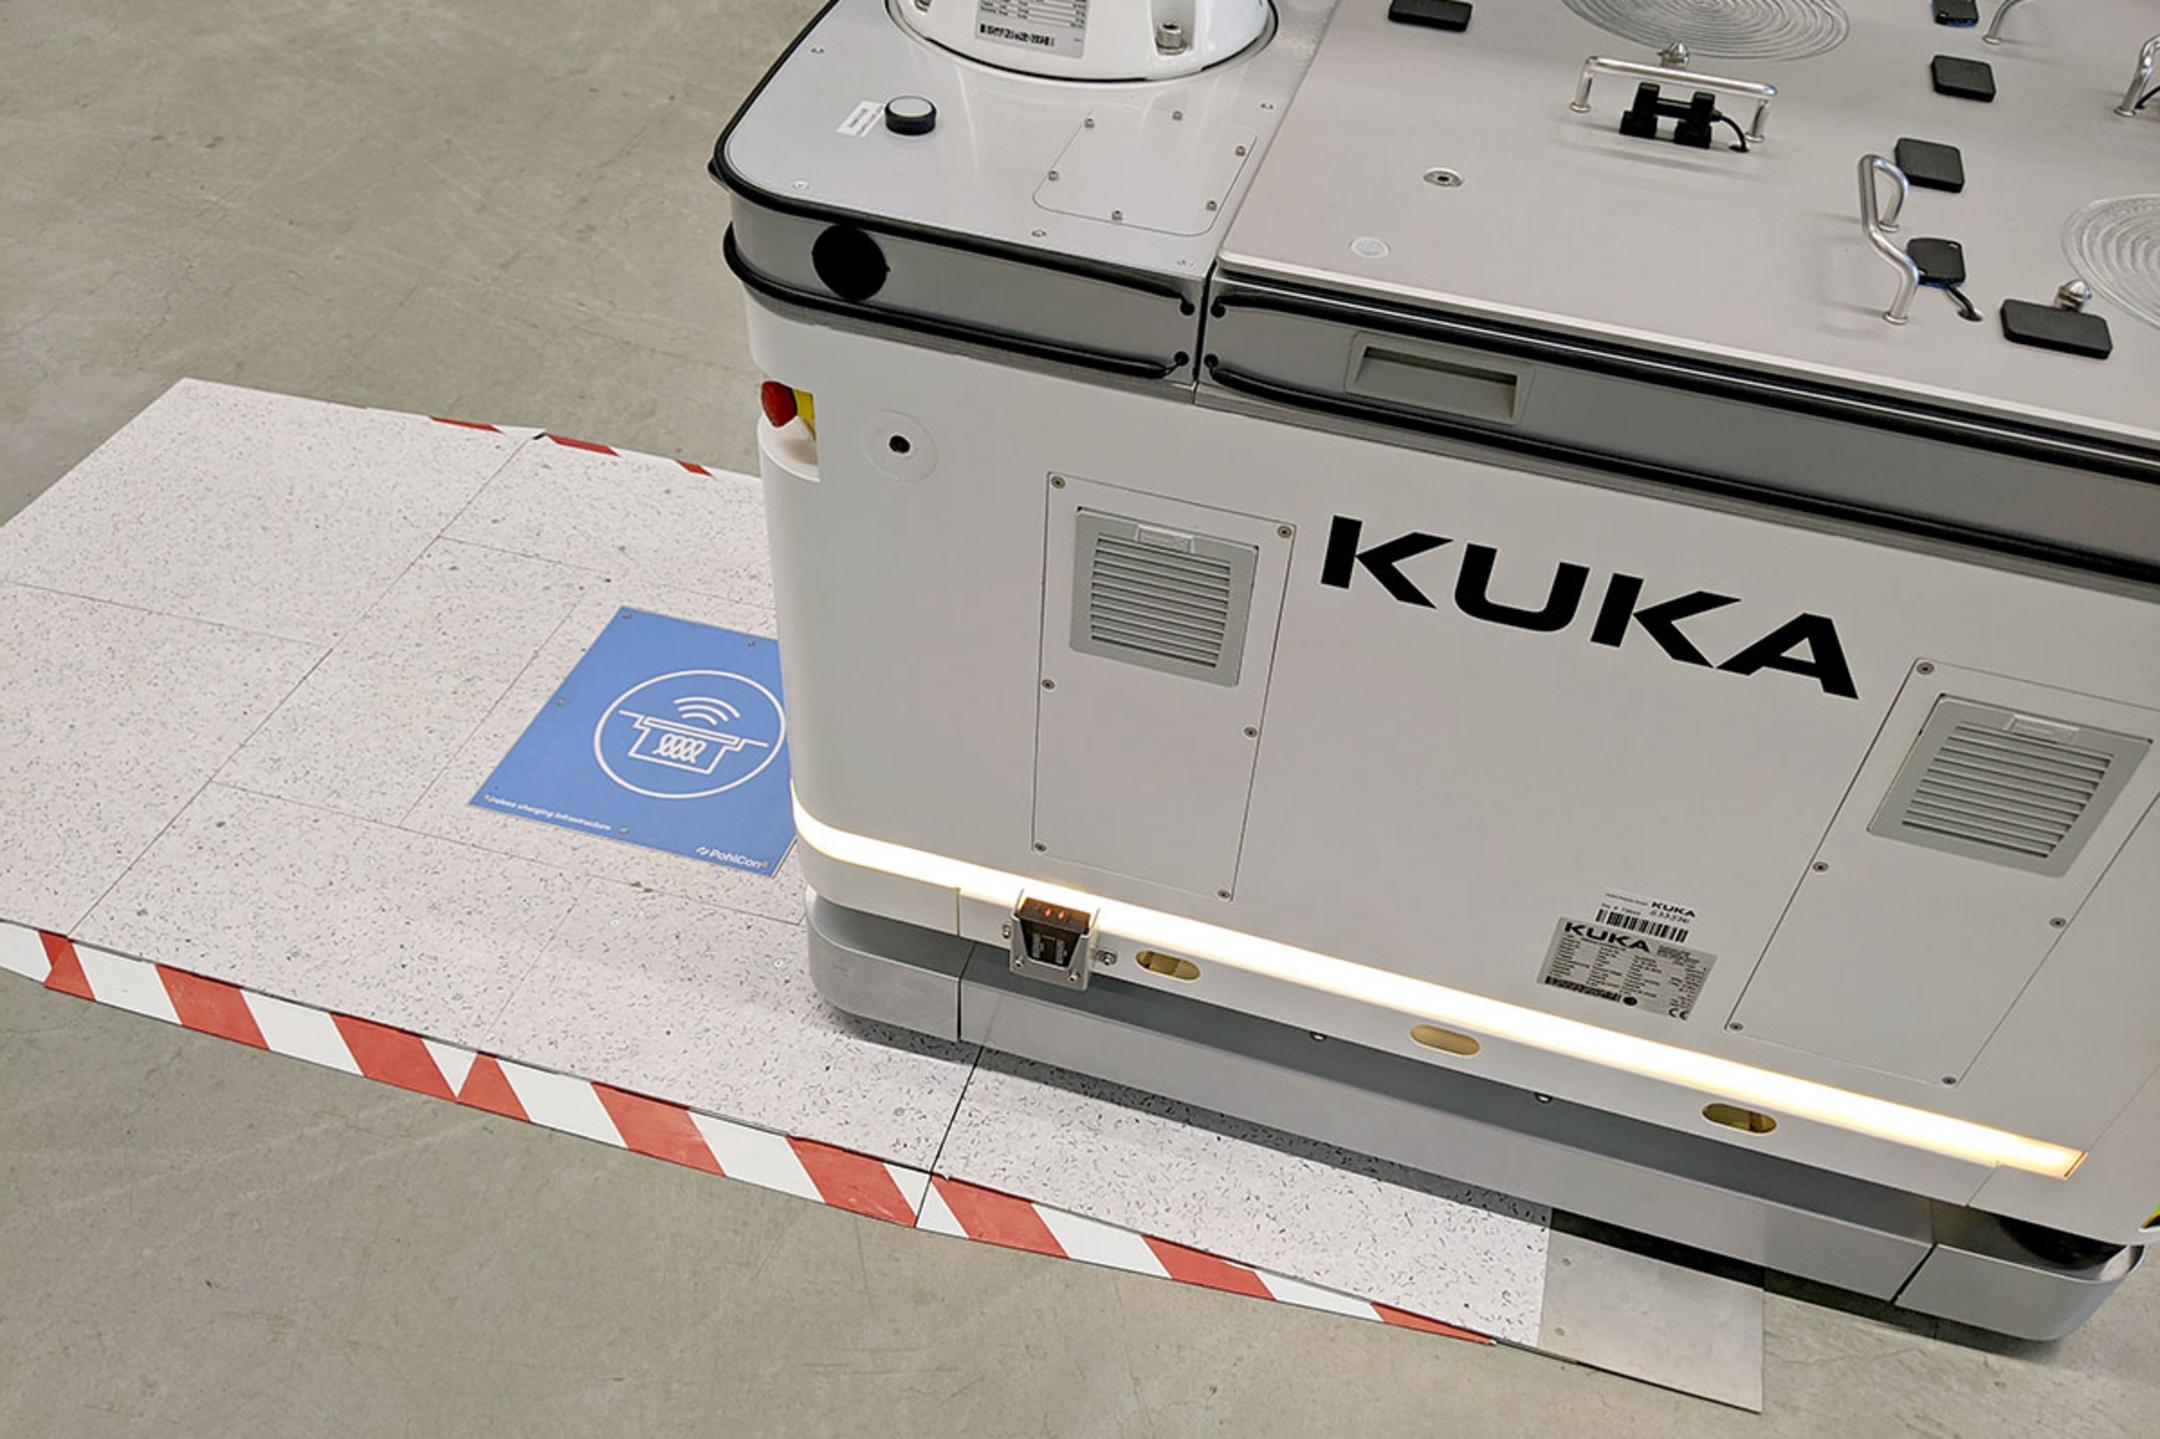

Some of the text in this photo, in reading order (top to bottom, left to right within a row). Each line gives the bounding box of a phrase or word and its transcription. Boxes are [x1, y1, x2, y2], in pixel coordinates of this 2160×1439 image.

[1319, 515, 1861, 700] KUKA
[1651, 901, 1696, 918] KUKA
[1564, 921, 1651, 953] KUKA
